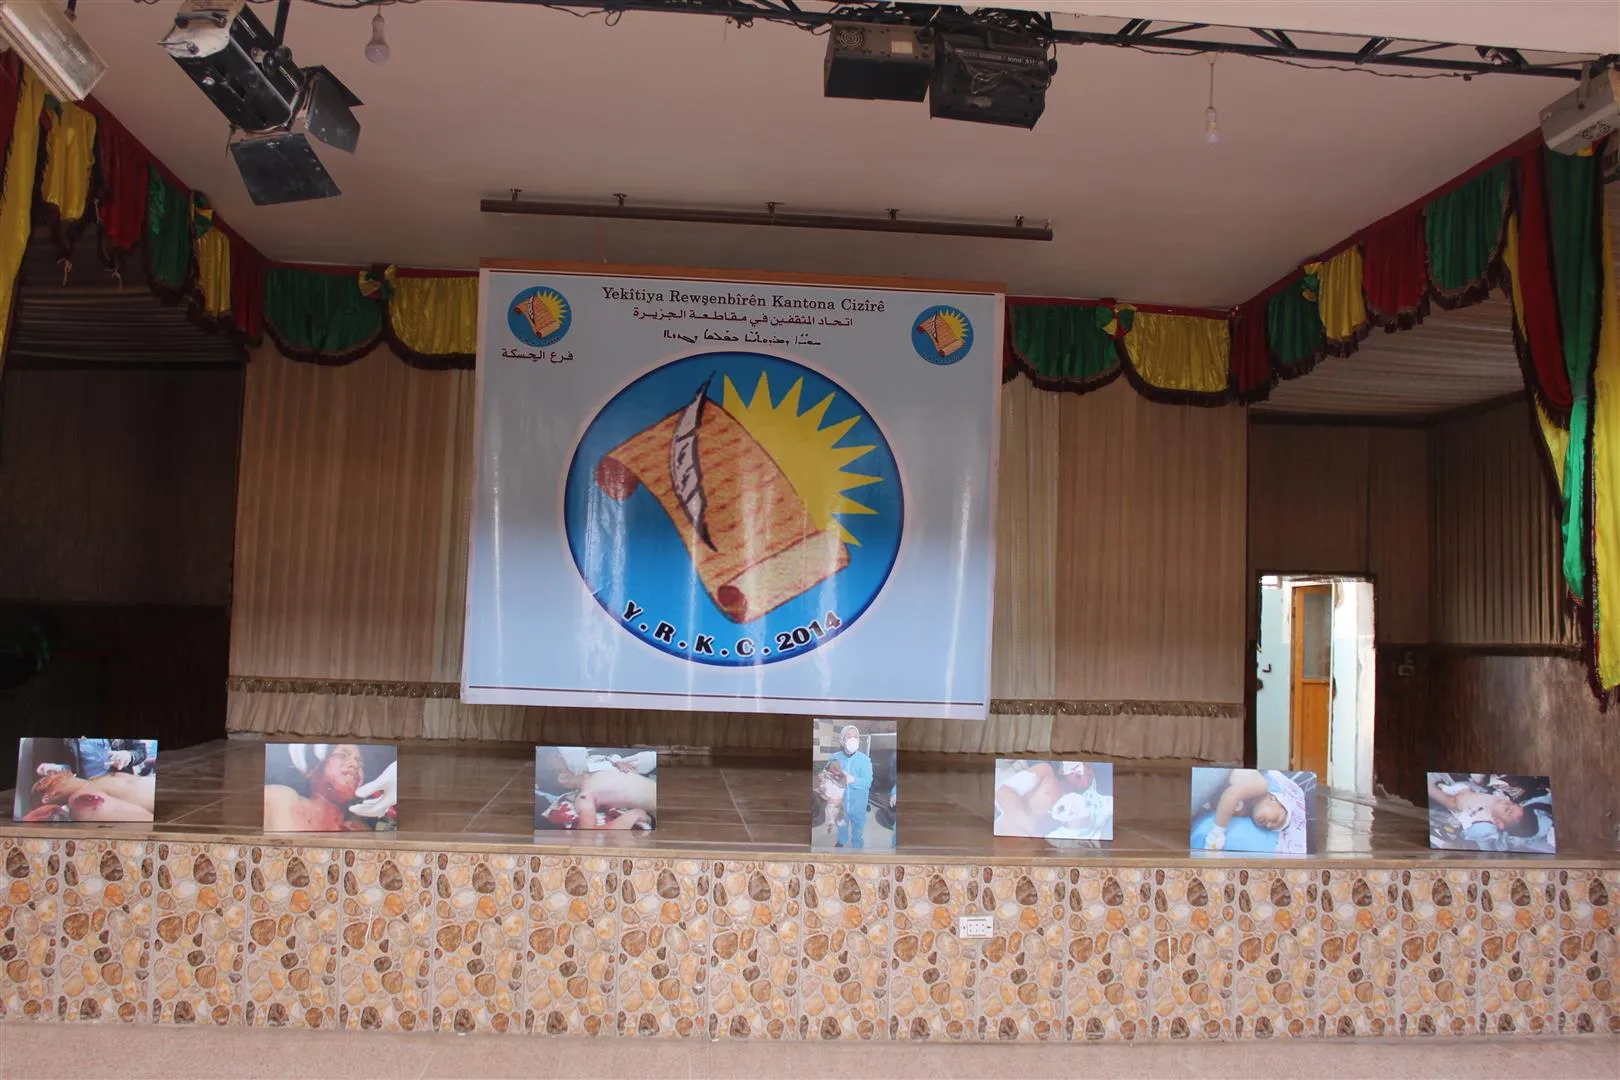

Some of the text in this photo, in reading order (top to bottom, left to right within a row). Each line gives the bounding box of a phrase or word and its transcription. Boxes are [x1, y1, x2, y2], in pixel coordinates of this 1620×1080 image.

[602, 287, 885, 312] Yekîtiya Rewşenbîrên Kantona Cizîrê
[633, 306, 686, 321] الجزيرة
[689, 309, 747, 322] مقاطعة
[749, 313, 769, 328] في
[818, 316, 853, 327] اتحاد
[550, 351, 574, 363] فرع
